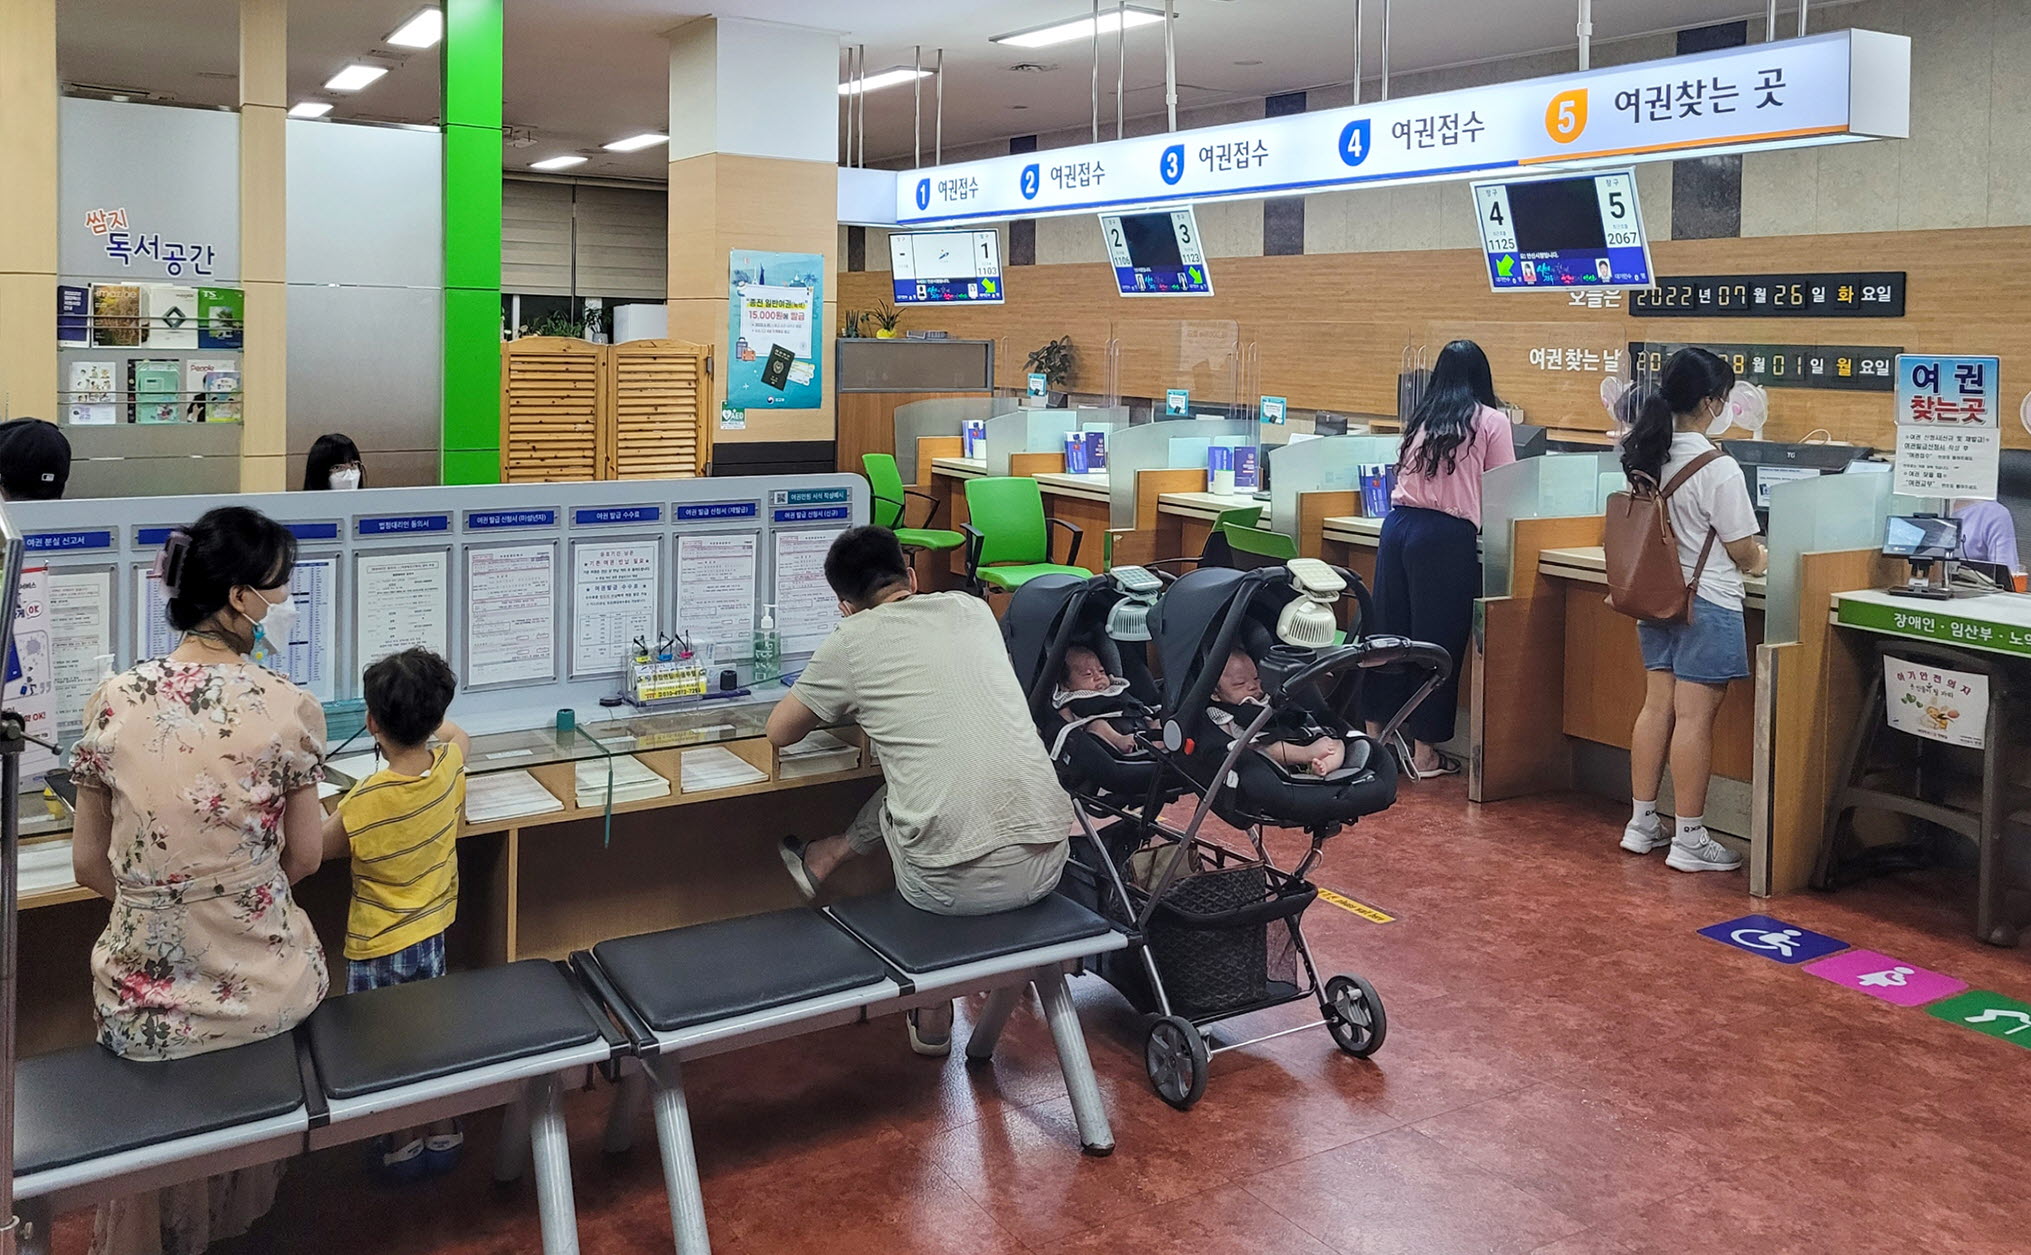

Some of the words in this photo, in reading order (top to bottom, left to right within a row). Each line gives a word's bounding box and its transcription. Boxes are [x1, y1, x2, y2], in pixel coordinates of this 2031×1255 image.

[1557, 100, 1576, 134] 5
[1615, 76, 1740, 124] 여권찾는
[1754, 68, 1786, 109] 곳
[1347, 129, 1362, 157] 4
[1392, 110, 1485, 150] 여권접수
[1166, 152, 1178, 178] 3
[1199, 139, 1269, 172] 여권접수
[1025, 170, 1035, 194] 2
[1050, 160, 1106, 189] 여권접수
[920, 184, 926, 205] 1
[938, 176, 979, 202] 여권접수
[1489, 201, 1504, 226] 4
[1608, 191, 1626, 219] 5
[86, 209, 128, 234] 쌈지
[1111, 228, 1122, 247] 2
[1179, 224, 1191, 244] 3
[1607, 231, 1637, 245] 2067
[106, 232, 215, 276] 독서공간
[980, 243, 989, 259] 1
[1488, 238, 1515, 251] 1125
[1182, 254, 1200, 263] 1123
[978, 267, 997, 275] 1103
[1637, 287, 1692, 306] 2022
[1699, 287, 1711, 304] 년
[1718, 285, 1746, 306] 07
[1753, 287, 1767, 304] 월
[1774, 285, 1803, 306] 26
[1811, 287, 1826, 304] 일
[1837, 285, 1855, 304] 화
[1860, 285, 1891, 303] 요일
[1529, 347, 1562, 370] 여권
[1565, 348, 1600, 372] 찾는
[1603, 348, 1623, 373] 날
[1752, 356, 1766, 374] 월
[1772, 354, 1802, 376] 01
[1810, 358, 1824, 375] 일
[1836, 357, 1852, 377] 월
[1859, 359, 1890, 376] 요일
[1910, 395, 1986, 423] 찾는곳
[596, 512, 609, 520] 여권
[623, 510, 640, 518] 수수료
[685, 509, 697, 517] 여권
[378, 521, 410, 530] 법정대리인
[411, 519, 430, 529] 동의서
[26, 538, 43, 547] 여권
[44, 537, 60, 547] 분실
[62, 535, 86, 546] 신고서
[28, 605, 40, 614] OK
[1894, 612, 1936, 634] 장애인
[1950, 621, 1994, 642] 임산부
[33, 711, 46, 721] OK!
